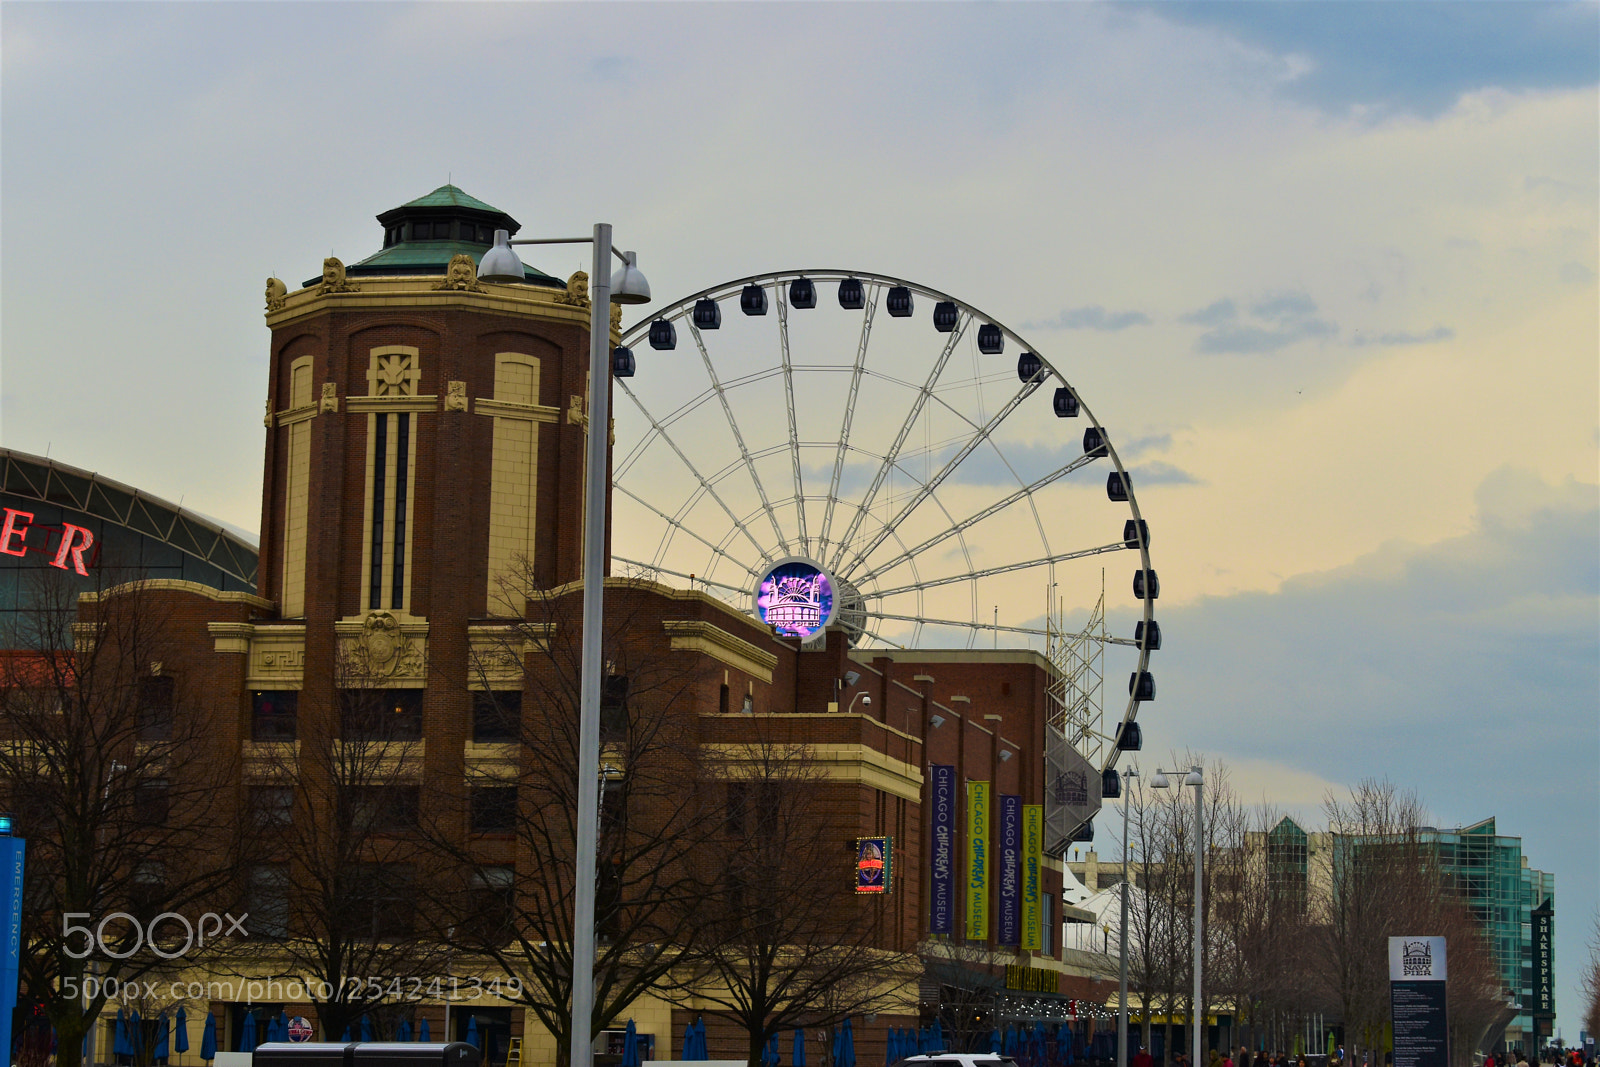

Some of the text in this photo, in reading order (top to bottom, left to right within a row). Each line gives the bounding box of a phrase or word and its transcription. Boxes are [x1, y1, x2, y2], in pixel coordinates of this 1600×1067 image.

[10, 850, 22, 958] EMERGENCY
[934, 768, 950, 930] CHICAGO CHILDREN'S MUSEUM
[970, 784, 985, 937] CHICAGO CHILDREN'S MUSEUM
[1002, 797, 1015, 943] CHICAGO CHILDREN'S MUSEUM
[1025, 807, 1038, 947] CHICAGO CHILDREN'S MUSEUM
[1539, 916, 1549, 1010] SHAKESPEARE
